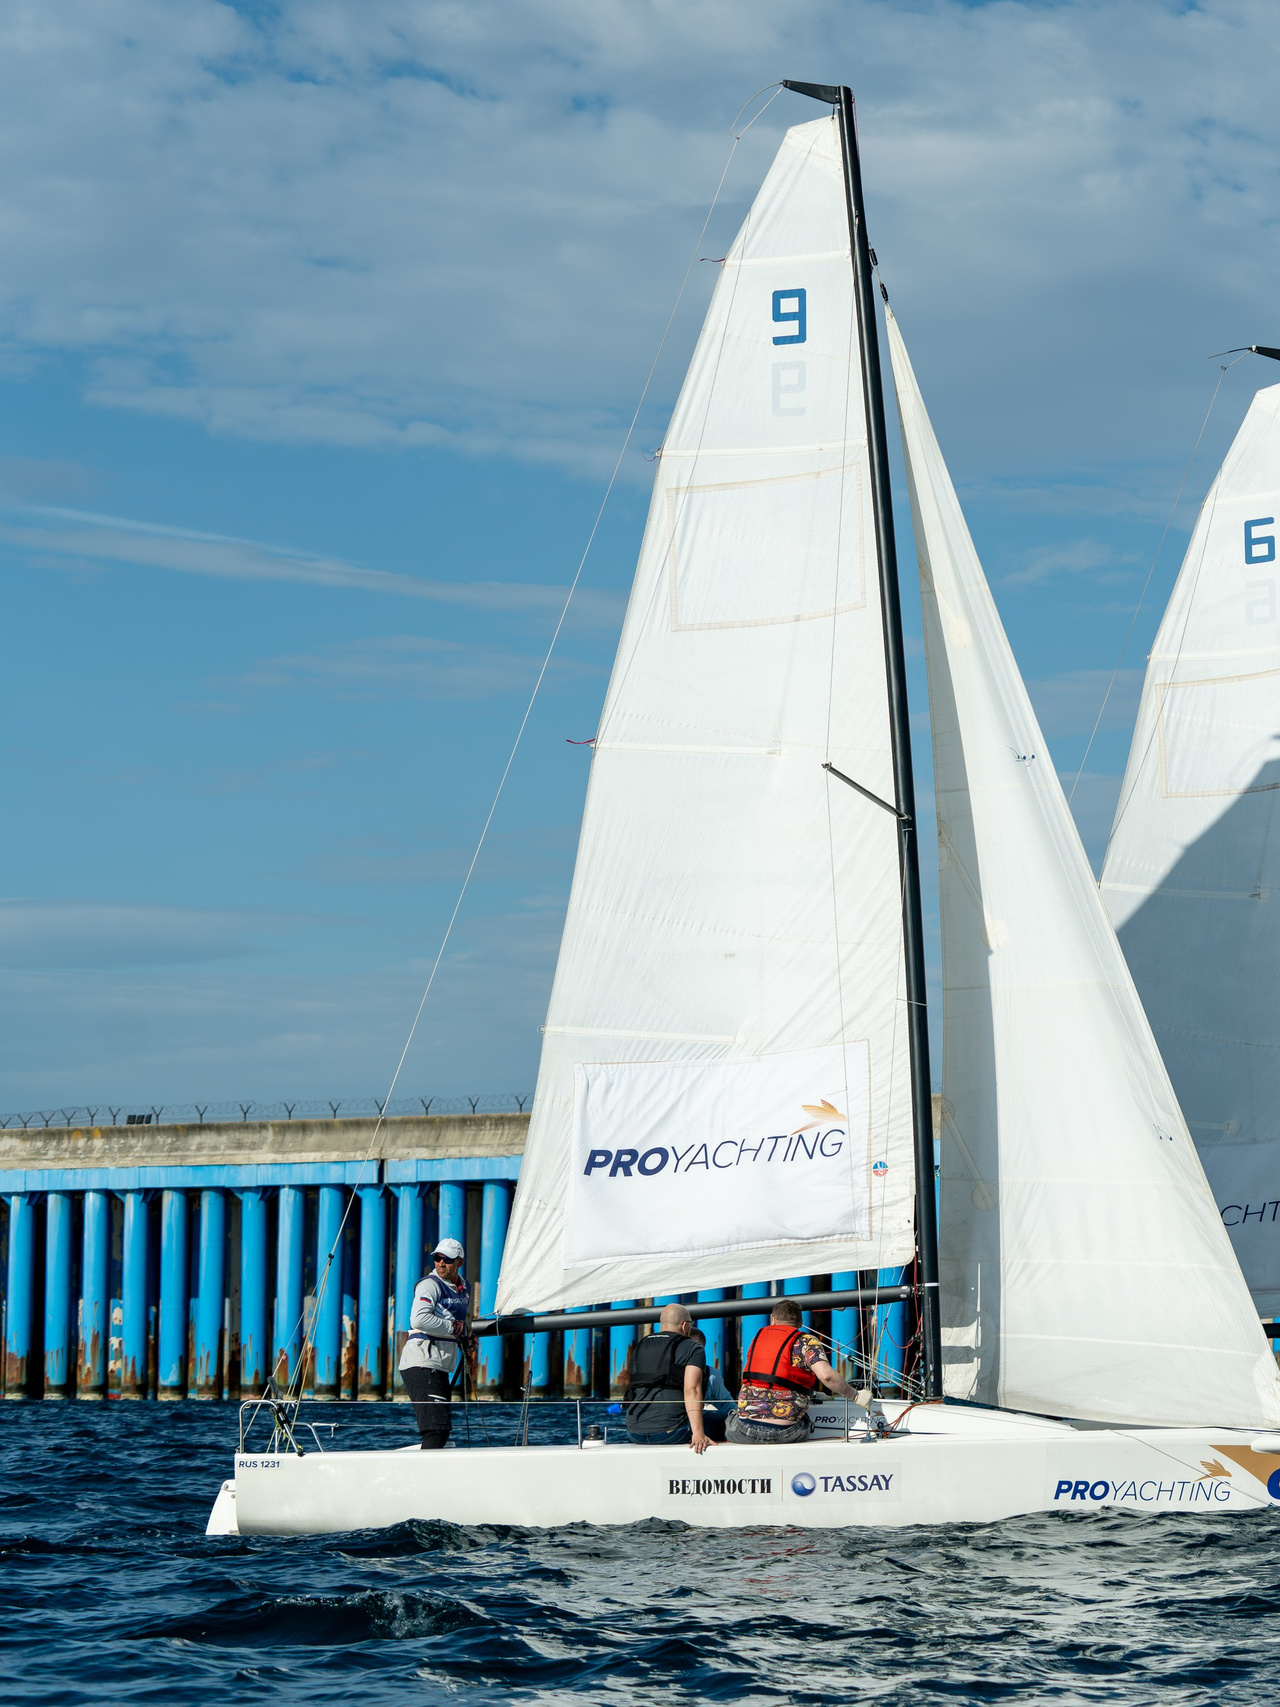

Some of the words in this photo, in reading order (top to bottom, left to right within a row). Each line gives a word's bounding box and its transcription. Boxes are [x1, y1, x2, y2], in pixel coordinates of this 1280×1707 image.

[772, 288, 806, 345] 9
[1244, 517, 1275, 565] 6
[583, 1129, 846, 1177] PROYACHTING
[238, 1460, 258, 1468] RUS
[260, 1460, 280, 1468] 1231
[668, 1478, 772, 1497] ВЕДОМОСТИ
[819, 1473, 894, 1493] TASSAY
[1054, 1480, 1231, 1502] PROYACHTING
